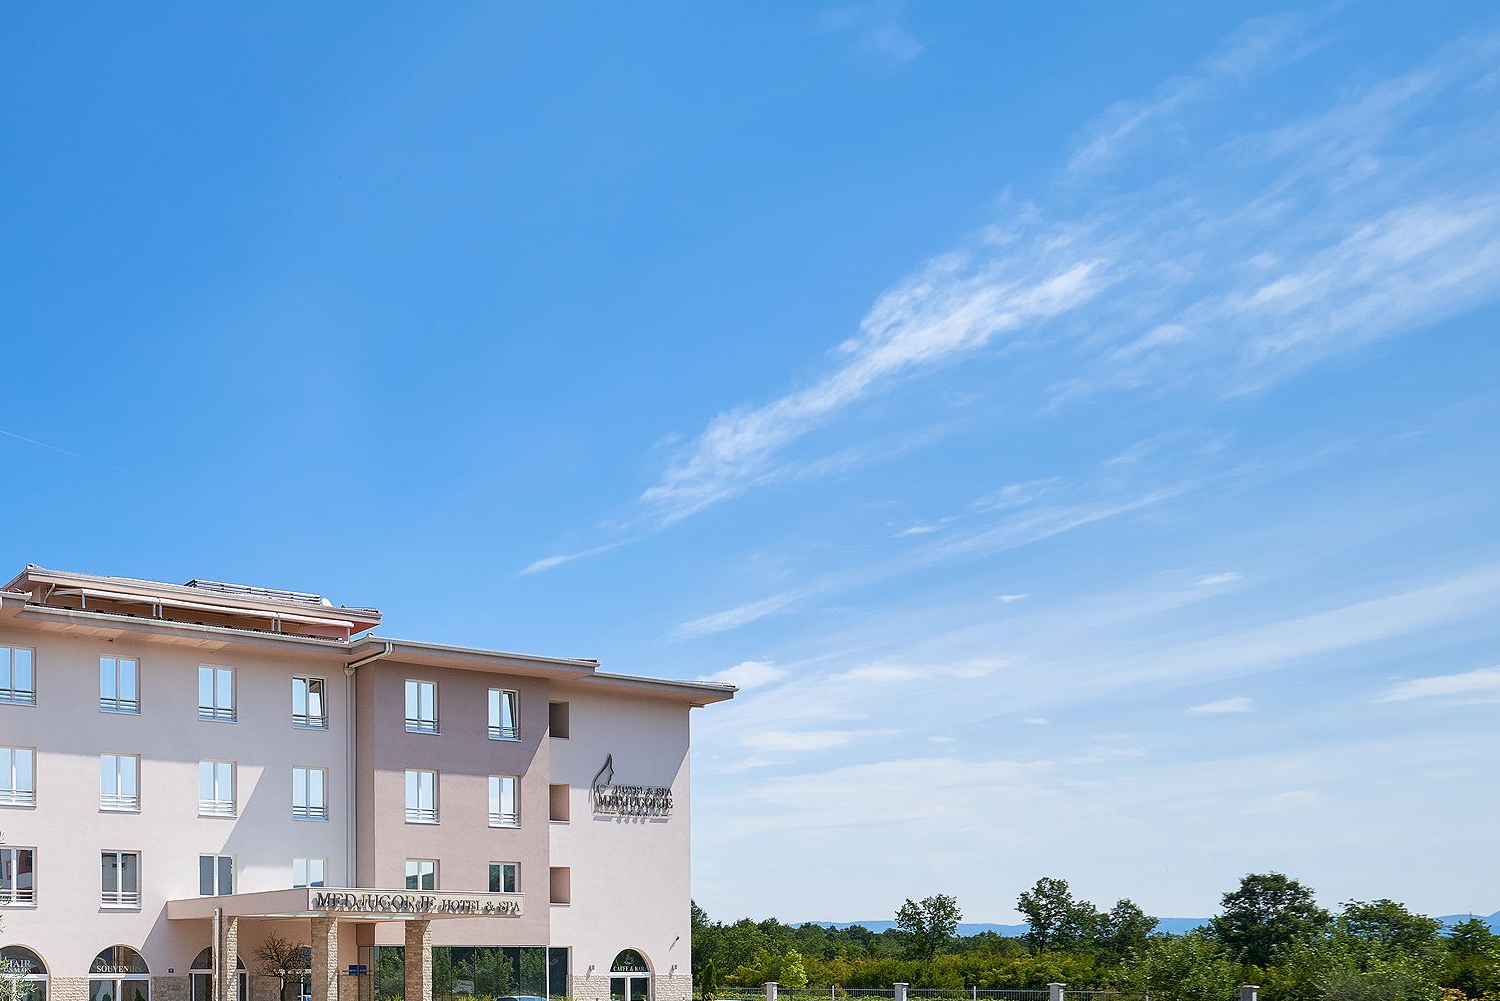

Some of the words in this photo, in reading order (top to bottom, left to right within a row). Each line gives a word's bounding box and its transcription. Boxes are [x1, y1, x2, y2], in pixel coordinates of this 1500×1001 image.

[316, 891, 437, 911] MEDJUGORJE
[440, 899, 483, 913] HOTEL
[485, 900, 496, 912] &
[498, 900, 521, 914] SPA
[96, 965, 142, 973] SOUVENIRS
